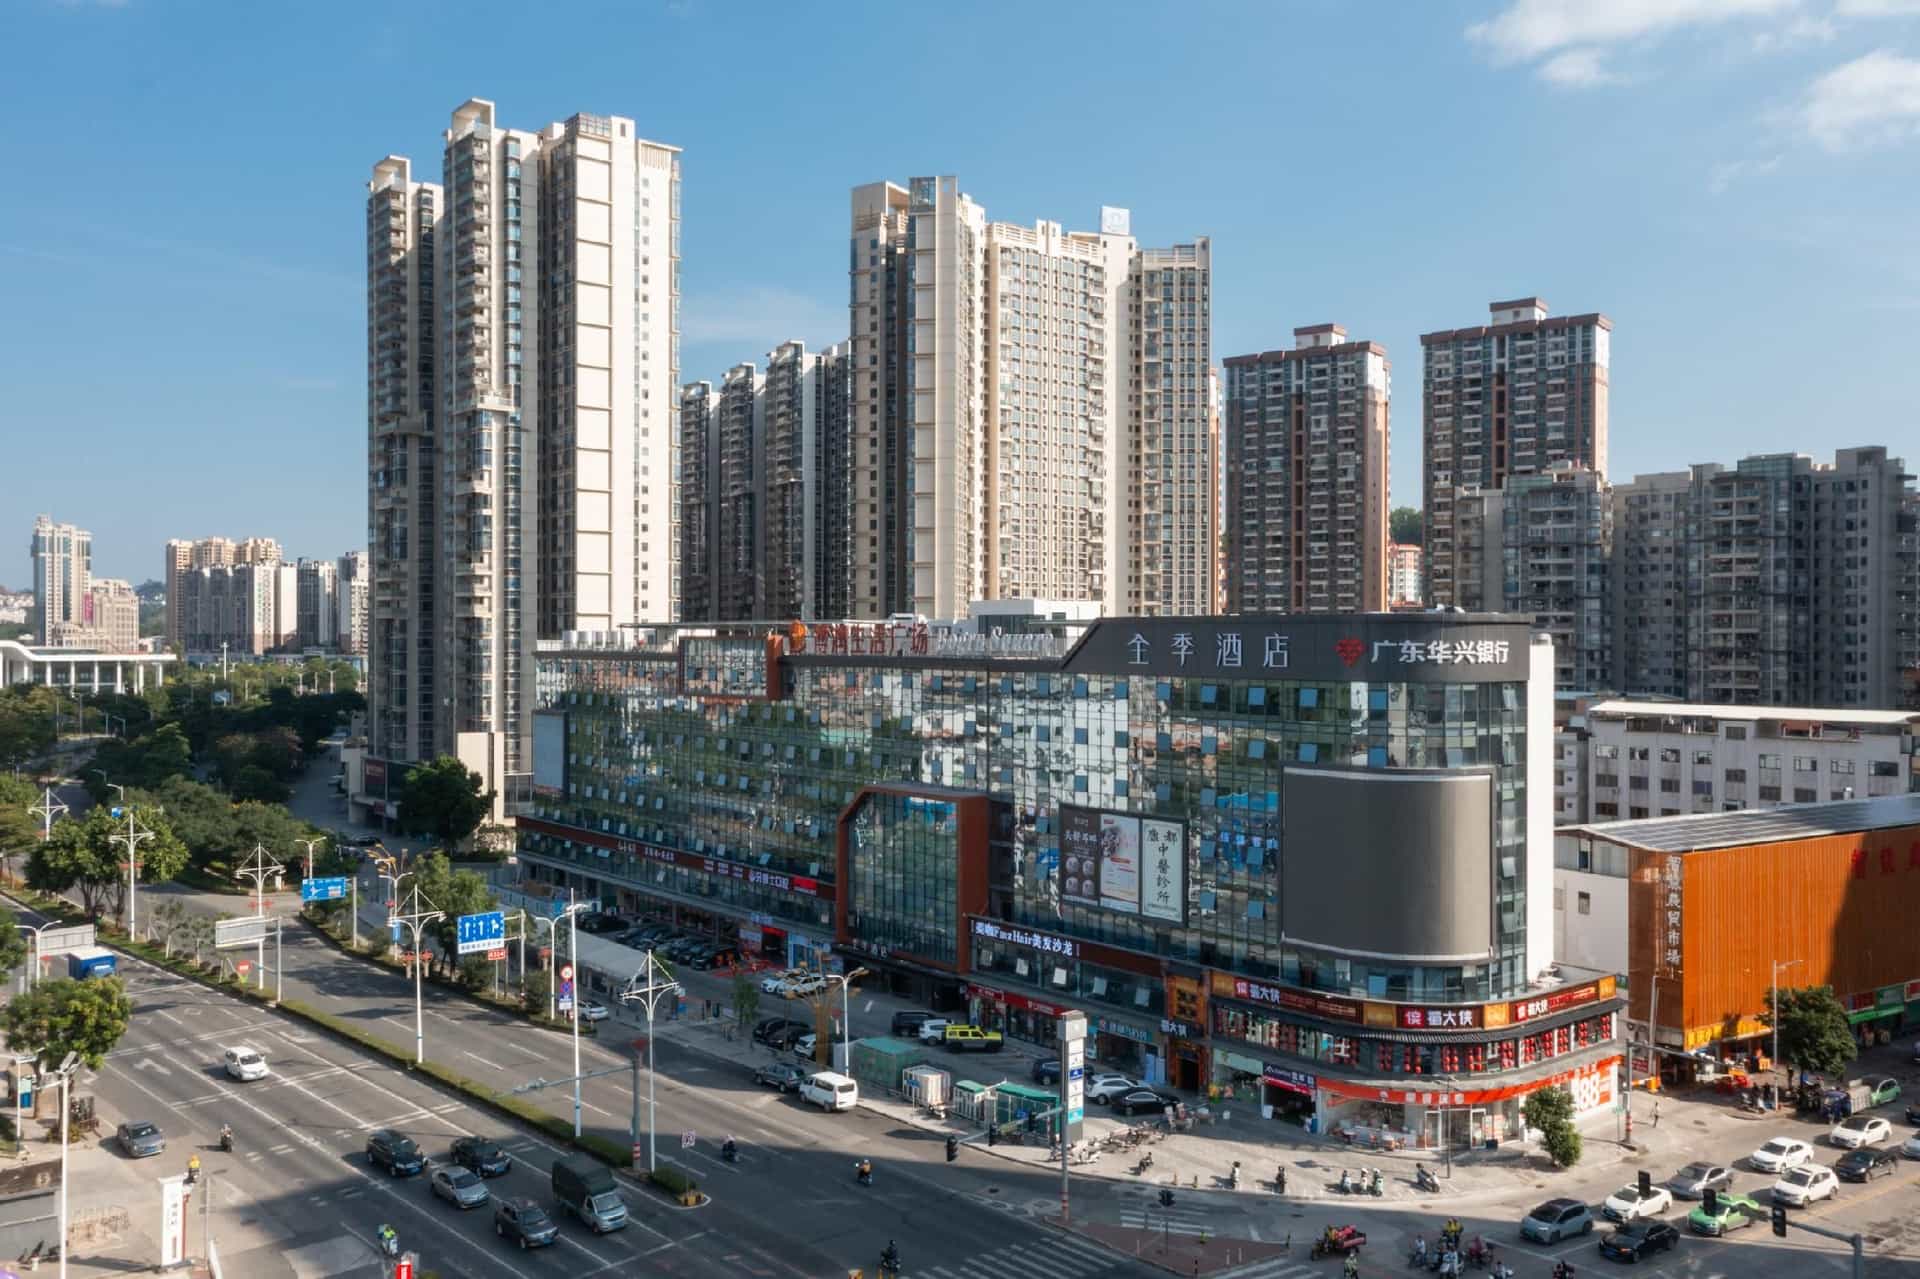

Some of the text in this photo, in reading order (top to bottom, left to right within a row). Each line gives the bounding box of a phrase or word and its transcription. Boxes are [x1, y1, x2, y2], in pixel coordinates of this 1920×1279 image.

[1127, 632, 1289, 667] 全季酒店
[1371, 640, 1509, 664] 广东华兴银行
